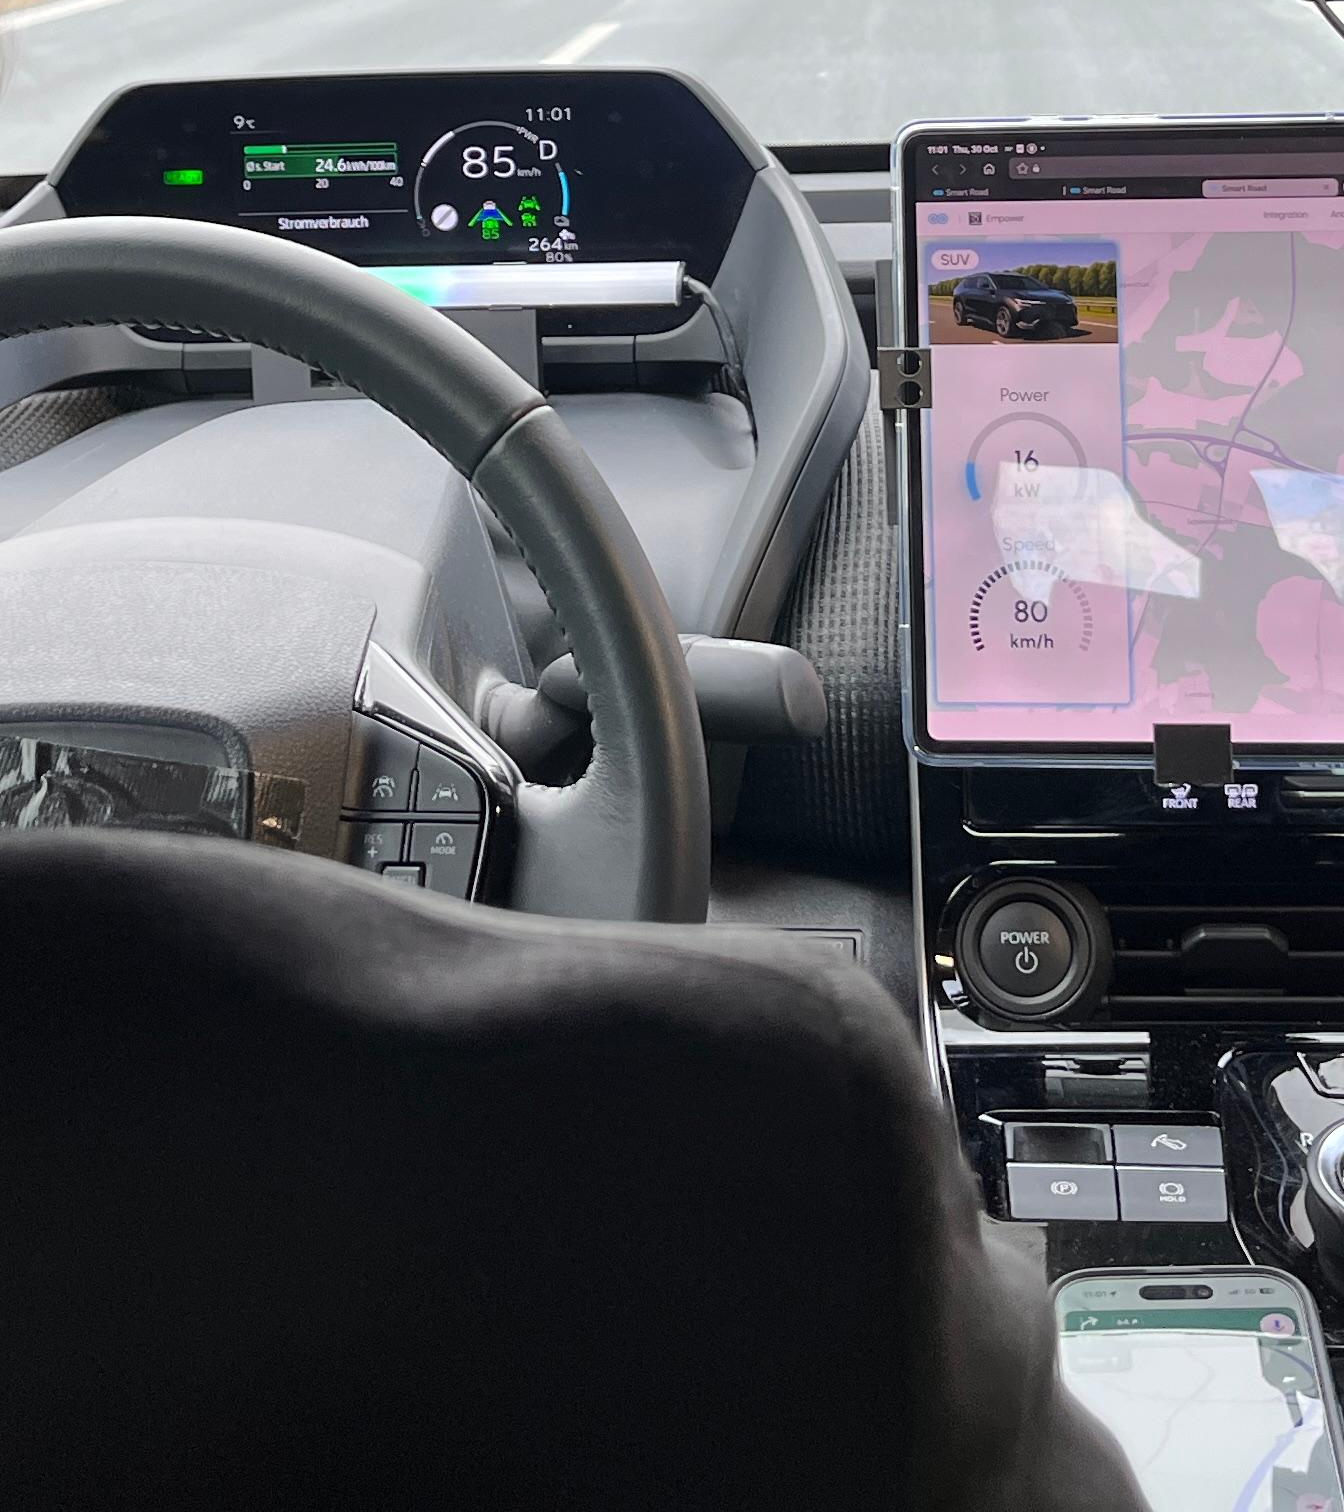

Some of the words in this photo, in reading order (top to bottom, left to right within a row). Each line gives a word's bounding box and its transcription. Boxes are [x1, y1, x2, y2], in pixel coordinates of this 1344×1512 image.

[525, 107, 571, 122] 11:01
[539, 139, 557, 160] D
[927, 145, 948, 154] 11:01
[952, 144, 971, 156] Thu,
[971, 144, 983, 154] 30
[983, 143, 999, 154] Oct
[462, 146, 516, 178] 85
[517, 167, 541, 177] km/h
[242, 180, 251, 190] 0
[315, 178, 329, 188] 20
[389, 176, 404, 186] 40
[946, 189, 969, 197] Smart
[969, 188, 990, 197] Road
[1082, 186, 1106, 195] Smart
[1107, 185, 1127, 194] Road
[1221, 183, 1246, 193] Smart
[1247, 183, 1268, 193] Road
[986, 214, 1024, 225] Empower
[1263, 209, 1309, 220] Integration
[278, 215, 369, 230] Stromverbrauch
[481, 228, 500, 239] 85
[528, 238, 563, 251] 264
[564, 242, 579, 250] km
[545, 251, 573, 262] 80%
[940, 253, 970, 266] SUV
[1000, 387, 1049, 403] Power
[1014, 450, 1039, 473] 16
[1014, 483, 1040, 498] kW
[1002, 536, 1055, 554] Speed
[1014, 599, 1048, 623] 80
[1009, 634, 1054, 650] km/h
[1162, 797, 1199, 809] FRONT
[1227, 797, 1257, 809] REAR
[430, 845, 457, 855] MODE
[1000, 930, 1050, 945] POWER
[1299, 1132, 1314, 1147] R
[1159, 1195, 1187, 1203] HOLD
